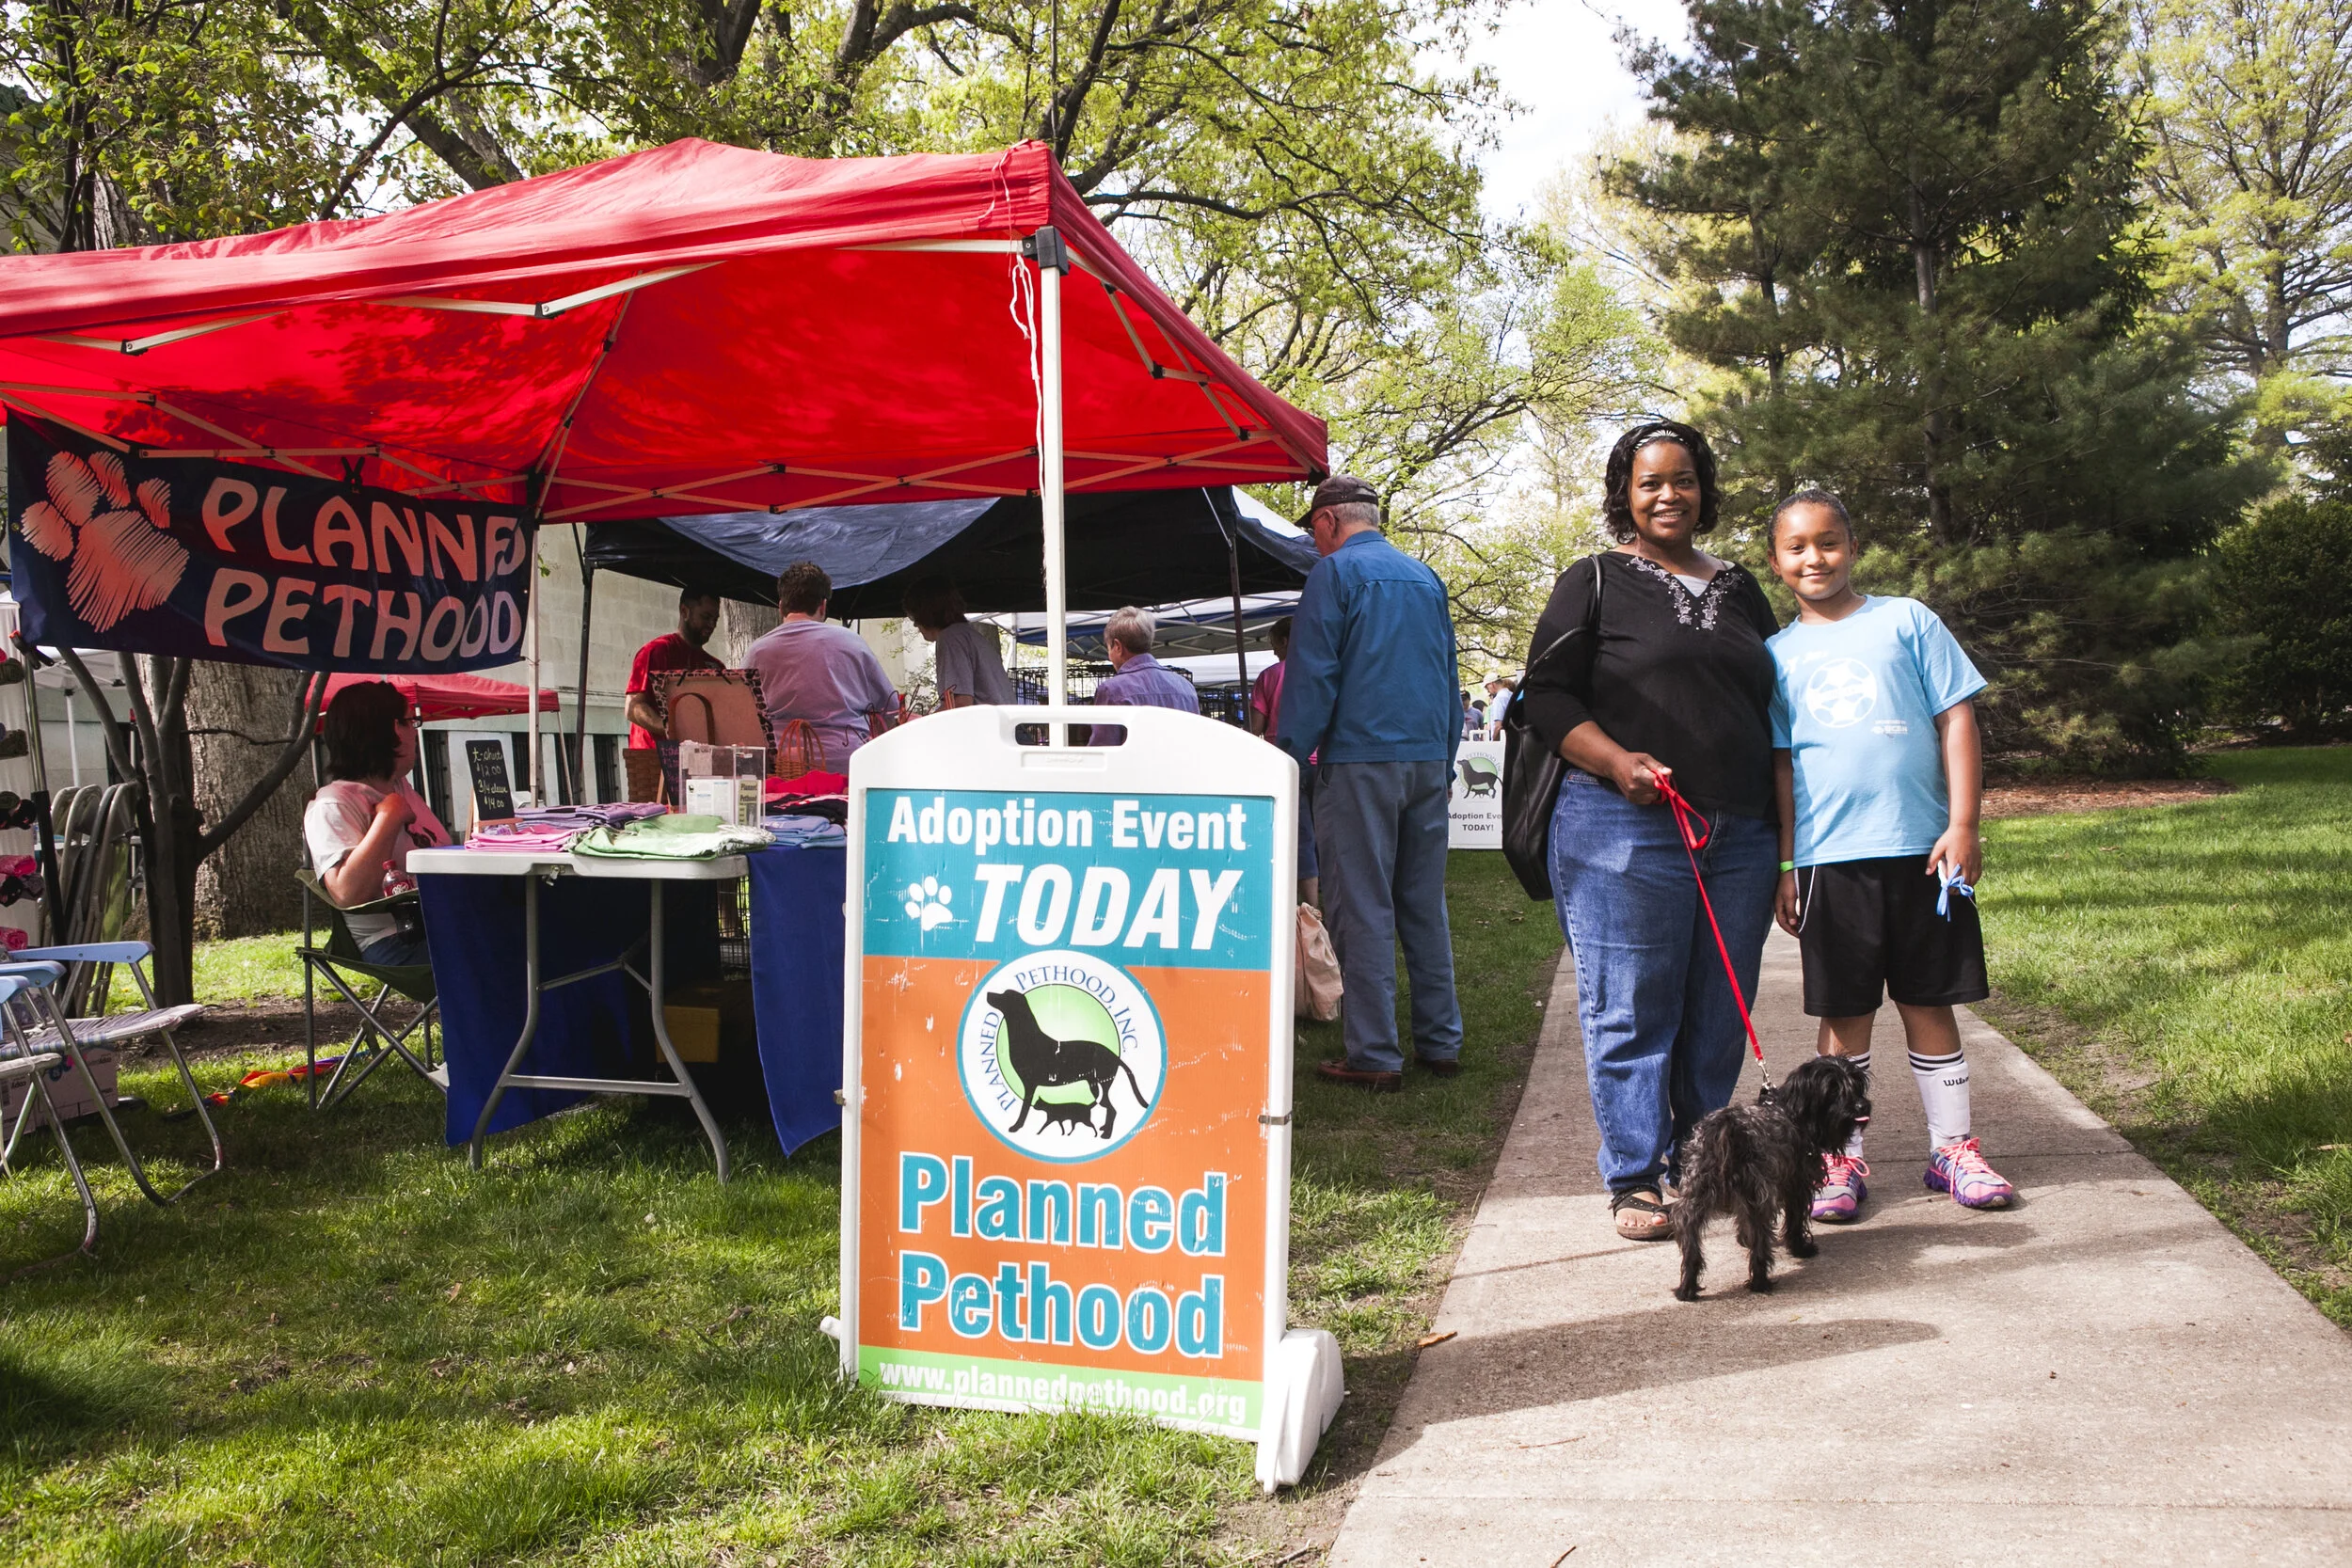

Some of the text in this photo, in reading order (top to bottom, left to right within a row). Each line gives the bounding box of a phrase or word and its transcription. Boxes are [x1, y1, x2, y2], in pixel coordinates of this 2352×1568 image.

[204, 567, 523, 661] PETHOOD
[887, 796, 1247, 856] Adoption Event
[974, 863, 1244, 950] TODAY
[980, 965, 1138, 1112] PLANNED PETHOOD, INC.
[898, 1151, 1227, 1258] Planned
[898, 1250, 1223, 1359] Pethood
[880, 1360, 1247, 1425] www.plannedpethood.org
